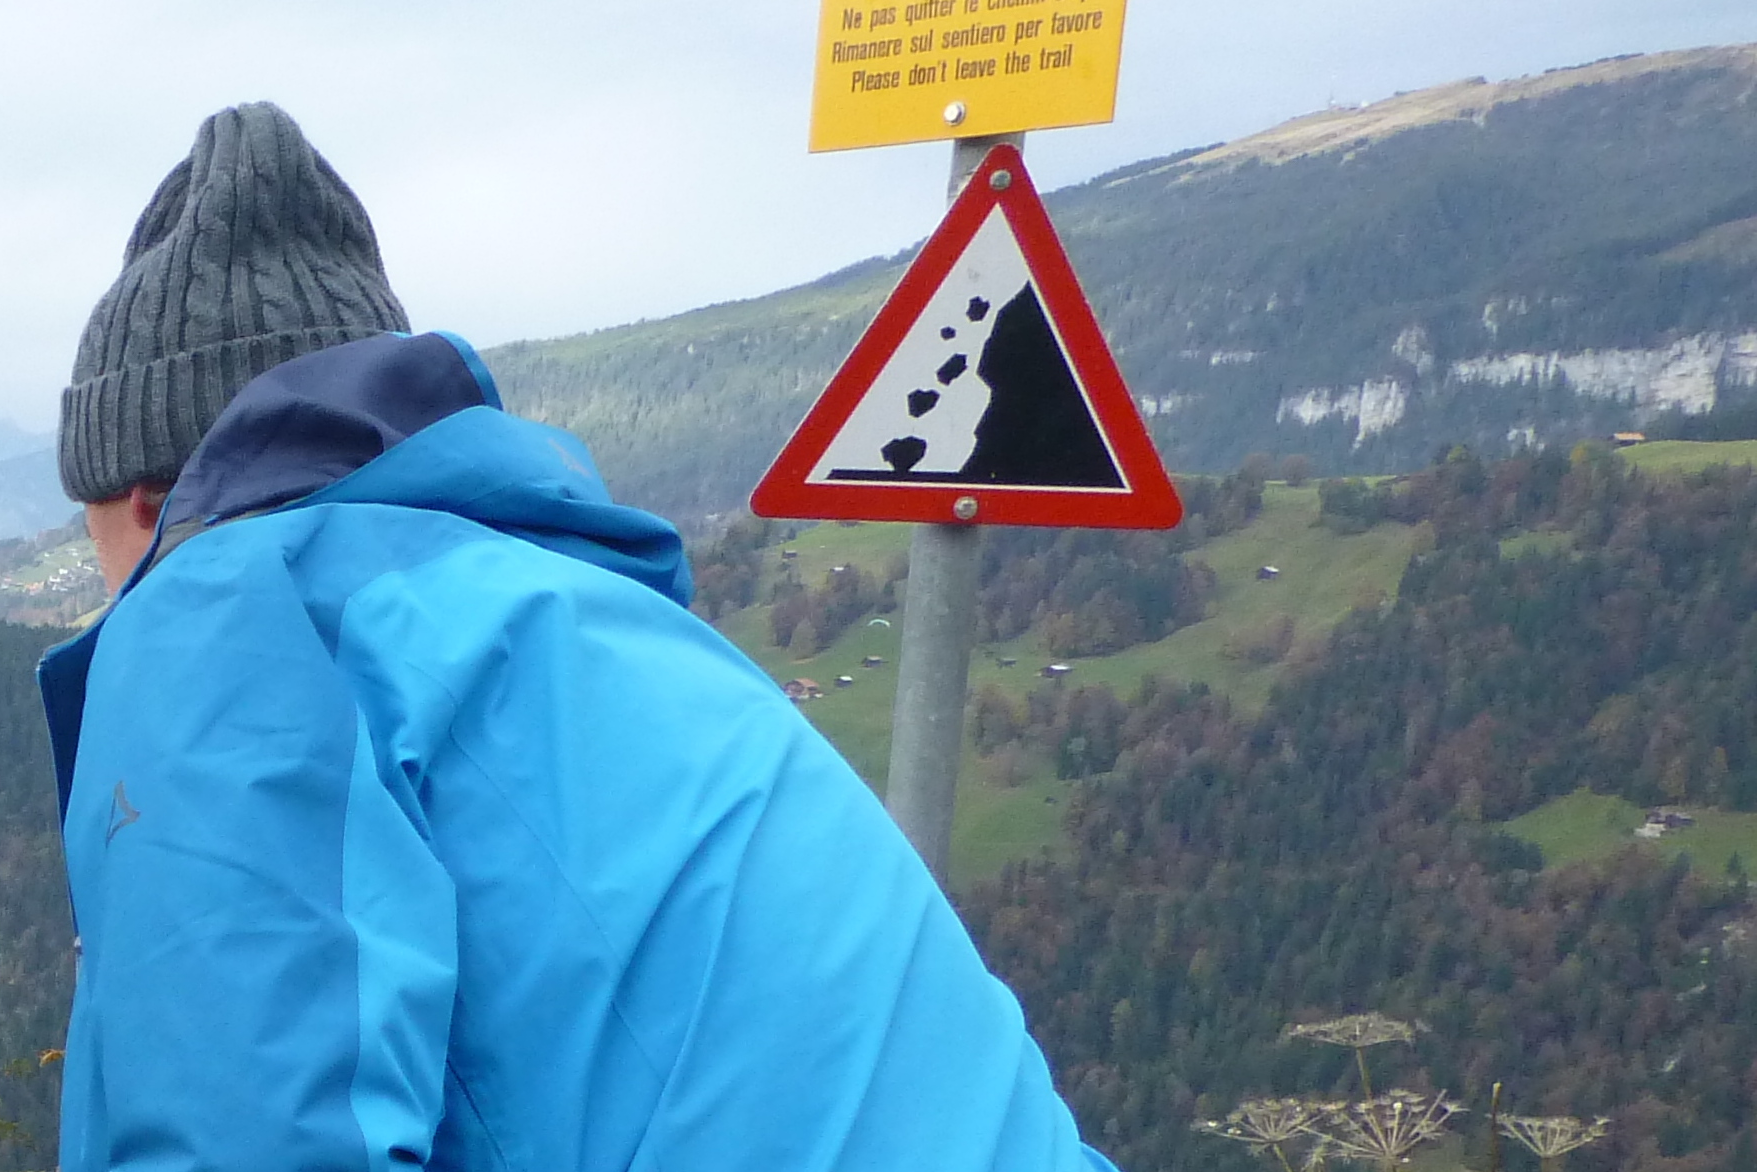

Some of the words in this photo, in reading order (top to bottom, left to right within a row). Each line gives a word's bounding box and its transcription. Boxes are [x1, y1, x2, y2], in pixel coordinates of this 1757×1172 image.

[832, 38, 902, 64] Rimanere
[910, 28, 934, 53] sul
[941, 22, 1006, 49] sentiero
[1014, 19, 1043, 45] per
[1051, 10, 1103, 35] favore
[842, 8, 862, 31] Ne
[870, 7, 896, 32] pas
[905, 0, 956, 26] quitter
[851, 69, 900, 93] Please
[908, 60, 947, 86] don't
[955, 57, 996, 81] leave
[1005, 50, 1030, 75] the
[1040, 43, 1073, 70] trail
